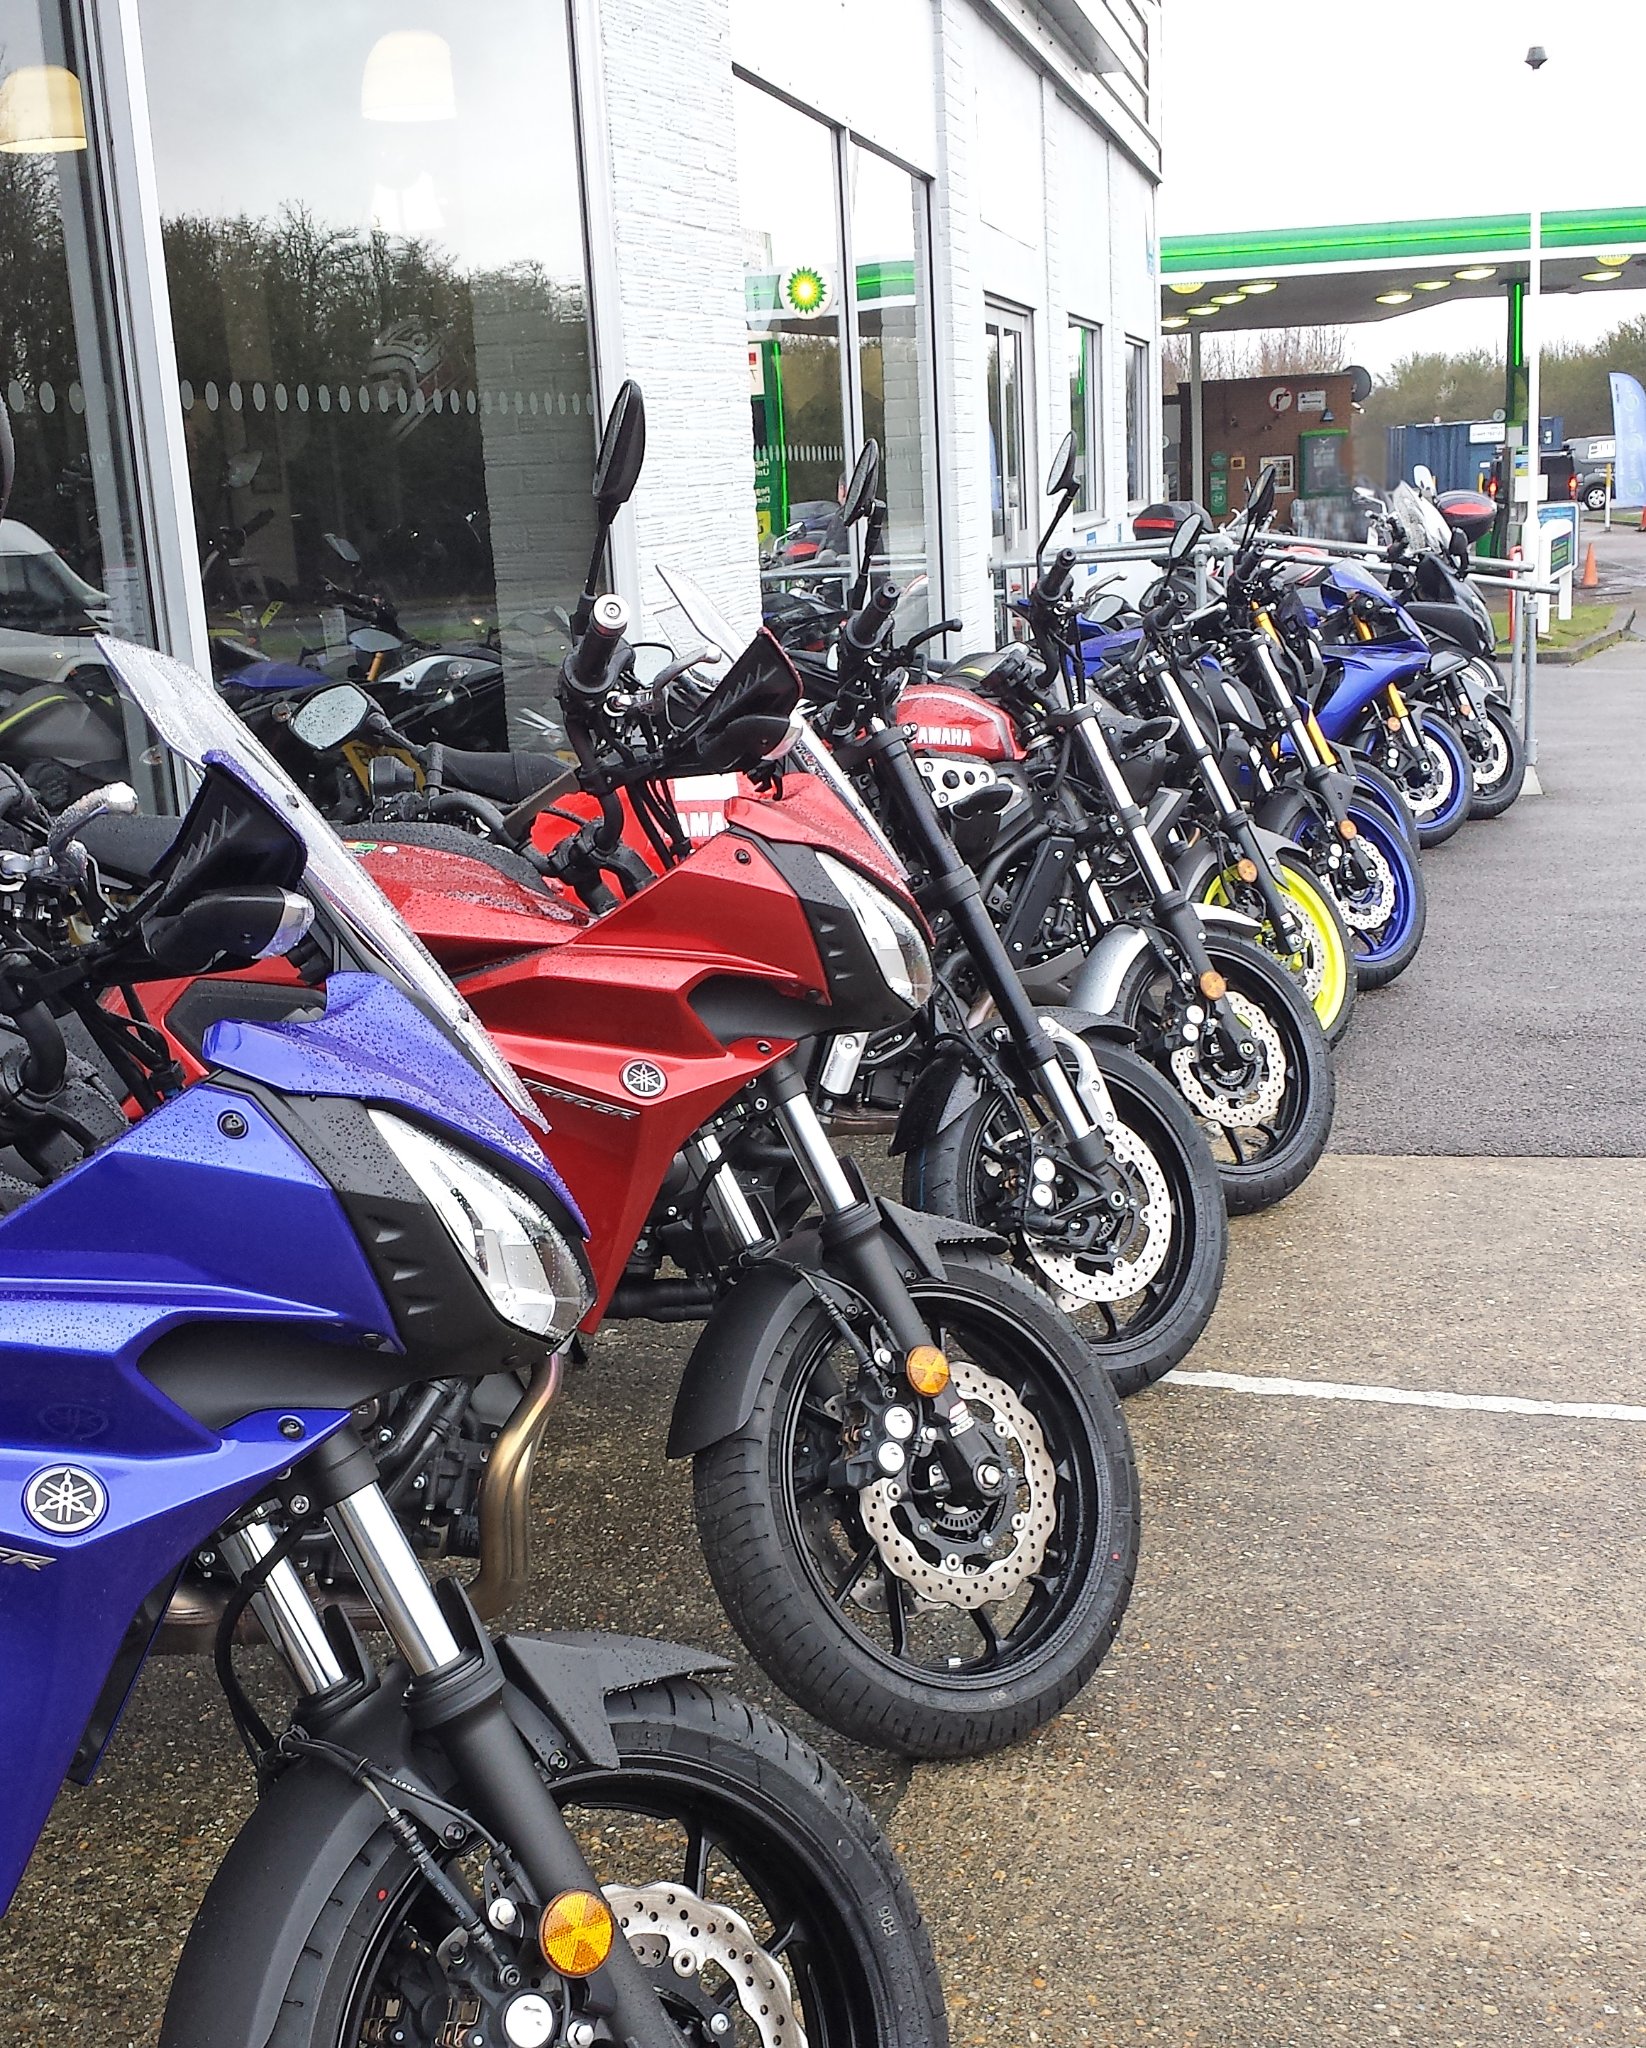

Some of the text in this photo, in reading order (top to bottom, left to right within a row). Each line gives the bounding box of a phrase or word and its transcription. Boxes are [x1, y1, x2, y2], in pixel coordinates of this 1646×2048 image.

[911, 726, 972, 746] AMAHA
[675, 811, 730, 838] AMA
[521, 1077, 641, 1120] TRACER
